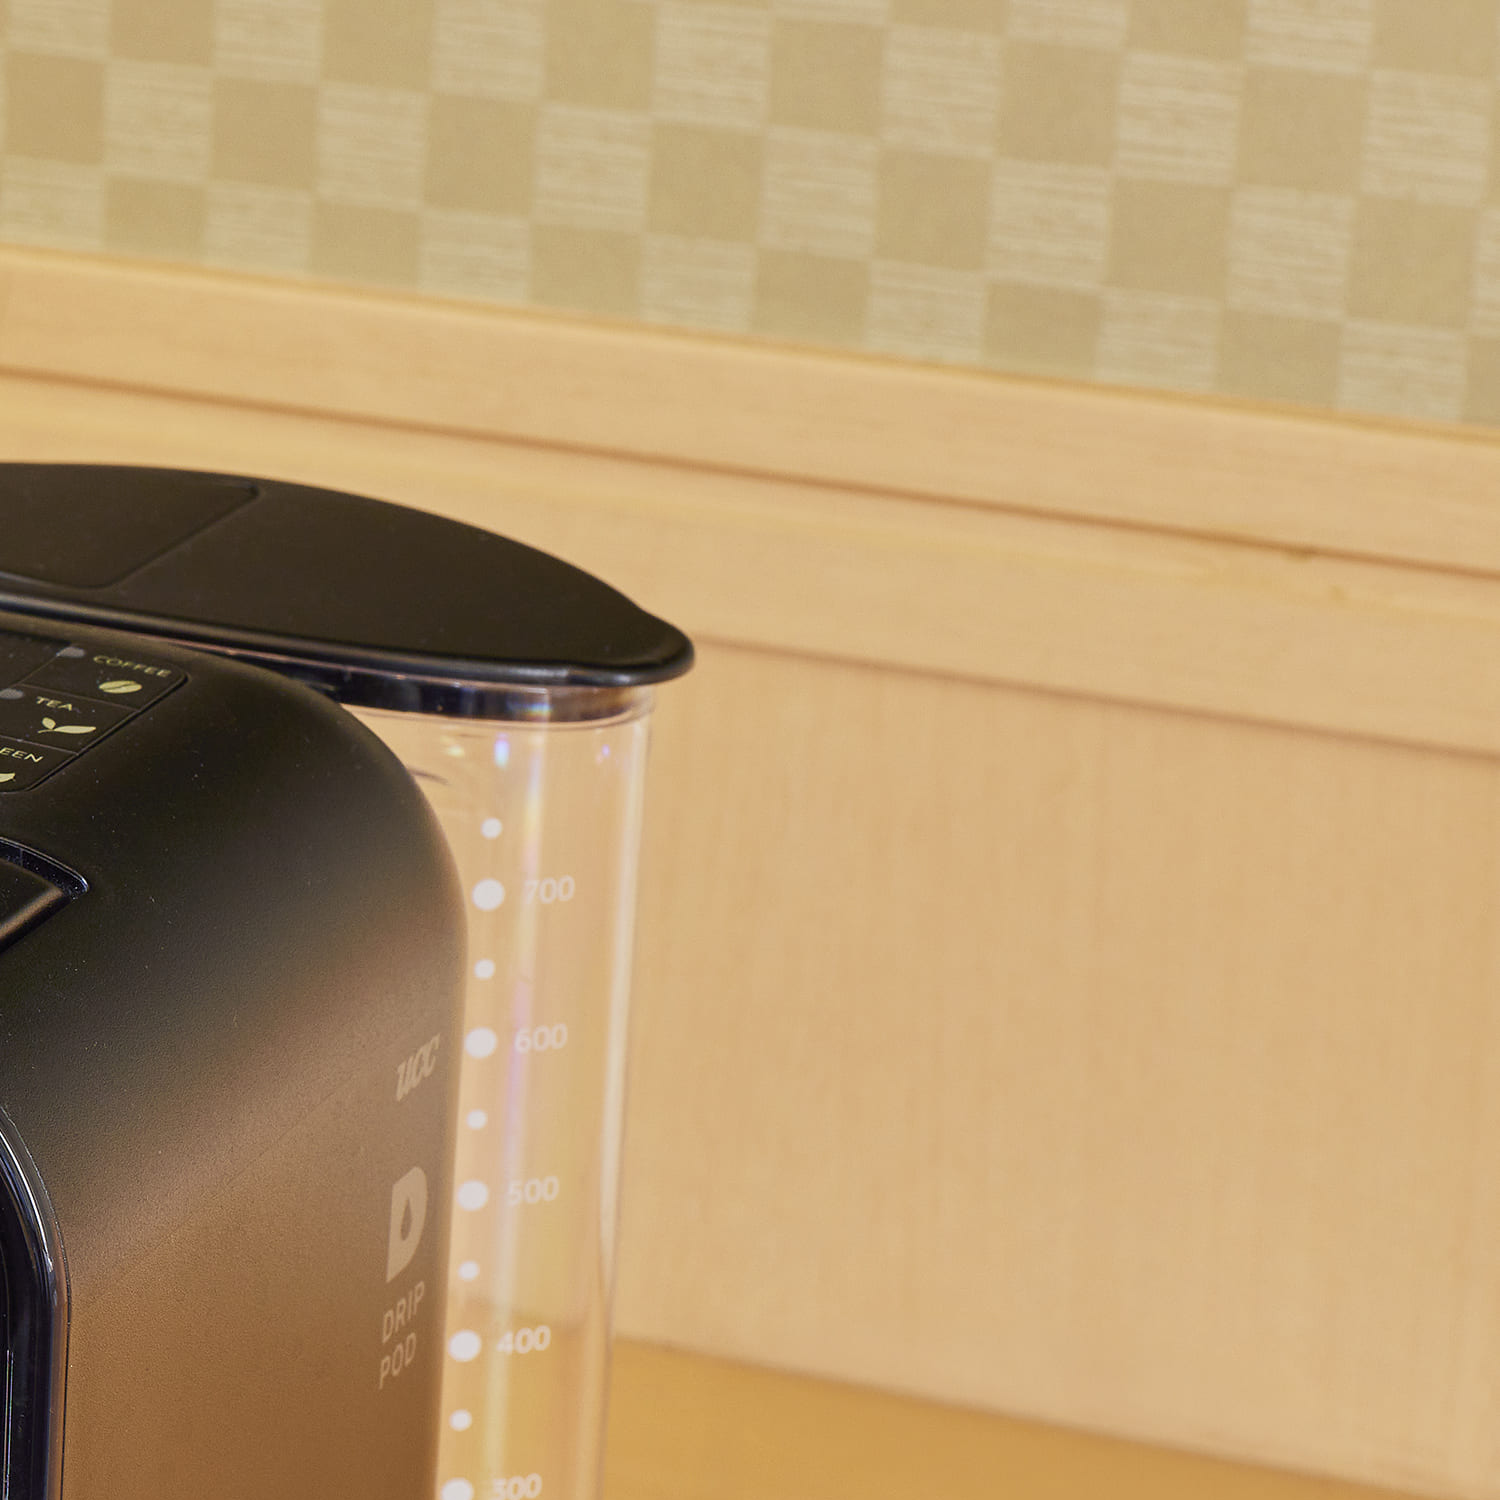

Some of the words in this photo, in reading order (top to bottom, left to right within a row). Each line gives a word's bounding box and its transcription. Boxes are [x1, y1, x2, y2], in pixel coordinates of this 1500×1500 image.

[93, 655, 172, 678] COFFEE
[36, 696, 73, 711] TEA
[523, 874, 576, 905] 700
[513, 1022, 569, 1054] 600
[505, 1175, 560, 1207] 500
[382, 1280, 425, 1345] DRIP
[496, 1325, 552, 1356] 400
[379, 1332, 417, 1390] POD
